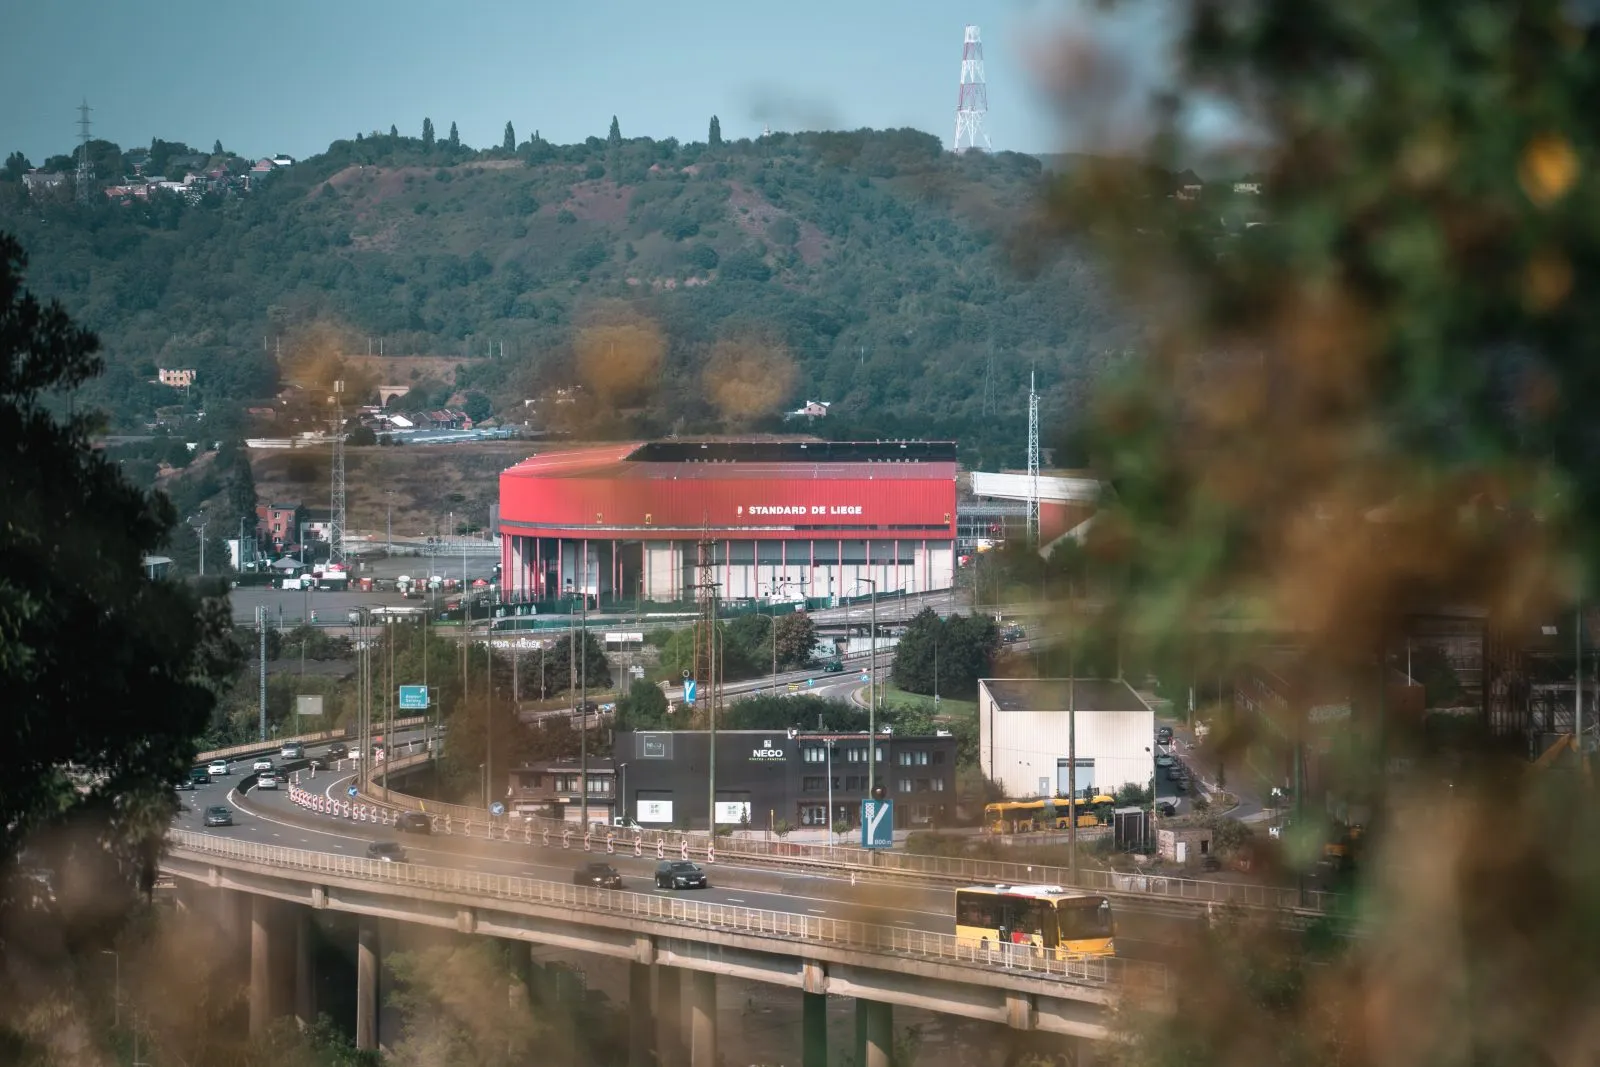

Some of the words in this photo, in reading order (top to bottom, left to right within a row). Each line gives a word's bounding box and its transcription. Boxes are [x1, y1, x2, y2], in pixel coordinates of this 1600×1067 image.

[748, 505, 807, 515] STANDARD
[811, 505, 826, 515] DE
[830, 505, 862, 515] LIEGE
[752, 749, 783, 758] NECO
